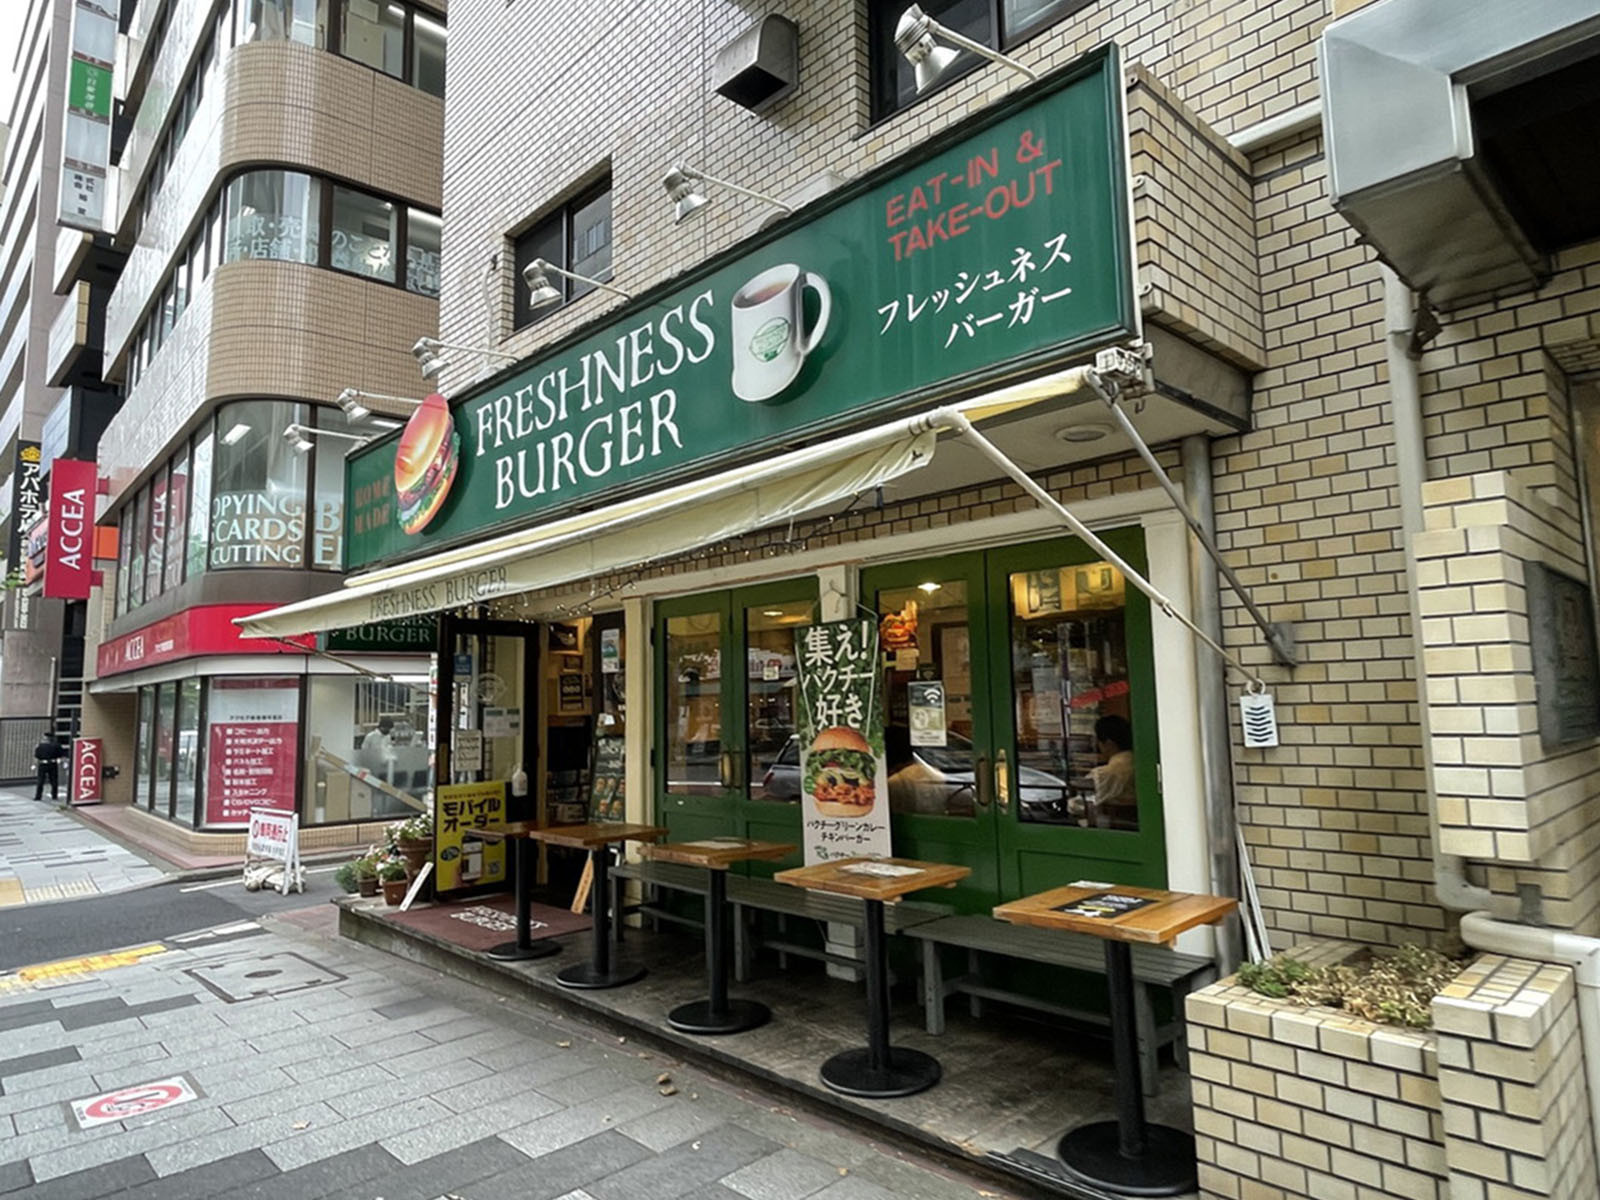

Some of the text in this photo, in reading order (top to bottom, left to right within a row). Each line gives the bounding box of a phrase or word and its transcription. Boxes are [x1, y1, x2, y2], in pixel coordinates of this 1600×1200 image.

[886, 130, 1046, 228] EAT-IN &
[888, 159, 1062, 262] TAKE-OUT
[878, 232, 1072, 335] フレッシュネス
[944, 286, 1072, 349] バーガー
[476, 290, 715, 456] FRESHNESS
[494, 388, 684, 510] BURGER
[58, 488, 86, 570] ACCEA
[211, 544, 301, 565] CUTTING
[215, 518, 304, 543] CARDS
[370, 566, 508, 619] FRESHNESS BURGER
[346, 625, 430, 643] BURGER
[802, 664, 874, 693] パクチー
[815, 692, 863, 730] 好き
[79, 740, 98, 799] ACCEA
[443, 796, 502, 818] モバイル
[443, 813, 501, 834] オーダー
